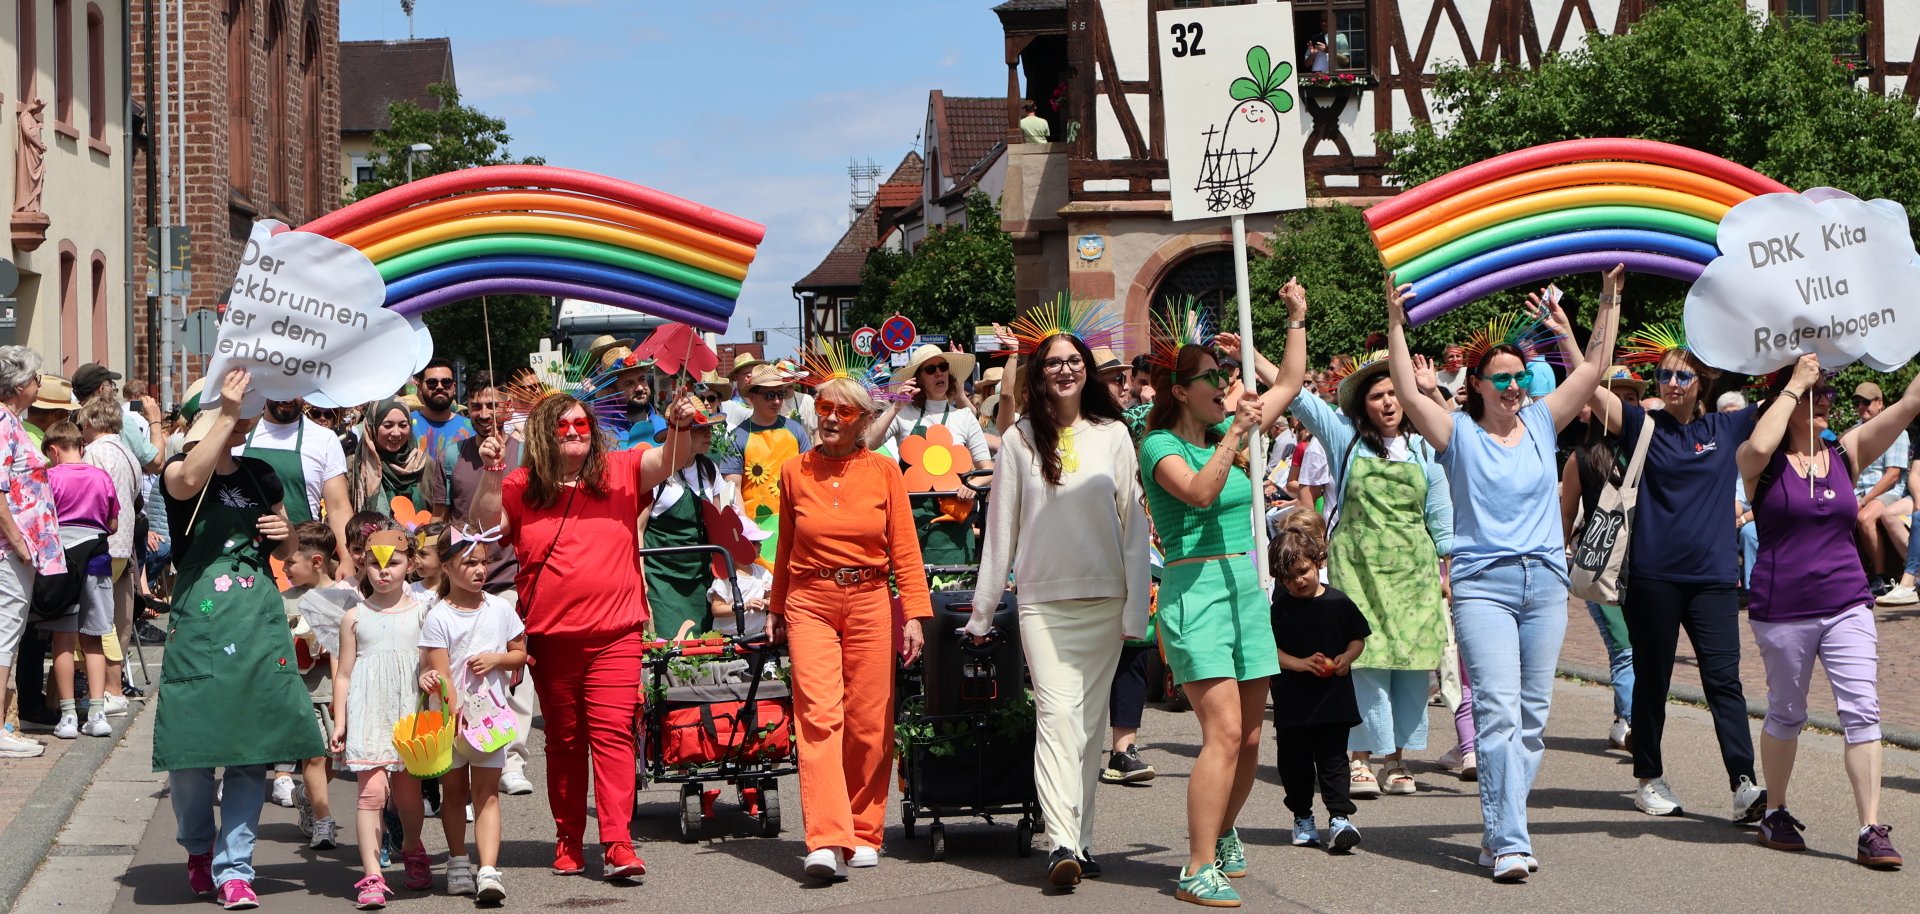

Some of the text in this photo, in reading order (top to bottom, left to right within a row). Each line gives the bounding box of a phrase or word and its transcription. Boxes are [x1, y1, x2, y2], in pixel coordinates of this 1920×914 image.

[1170, 22, 1206, 58] 32
[240, 238, 285, 275] Der
[1748, 223, 1867, 268] DRK Kita
[1795, 276, 1849, 305] Villa
[271, 316, 327, 349] dem
[858, 335, 872, 348] 30
[1754, 307, 1896, 353] Regenbogen
[218, 338, 332, 380] enbogen
[531, 355, 543, 364] 33
